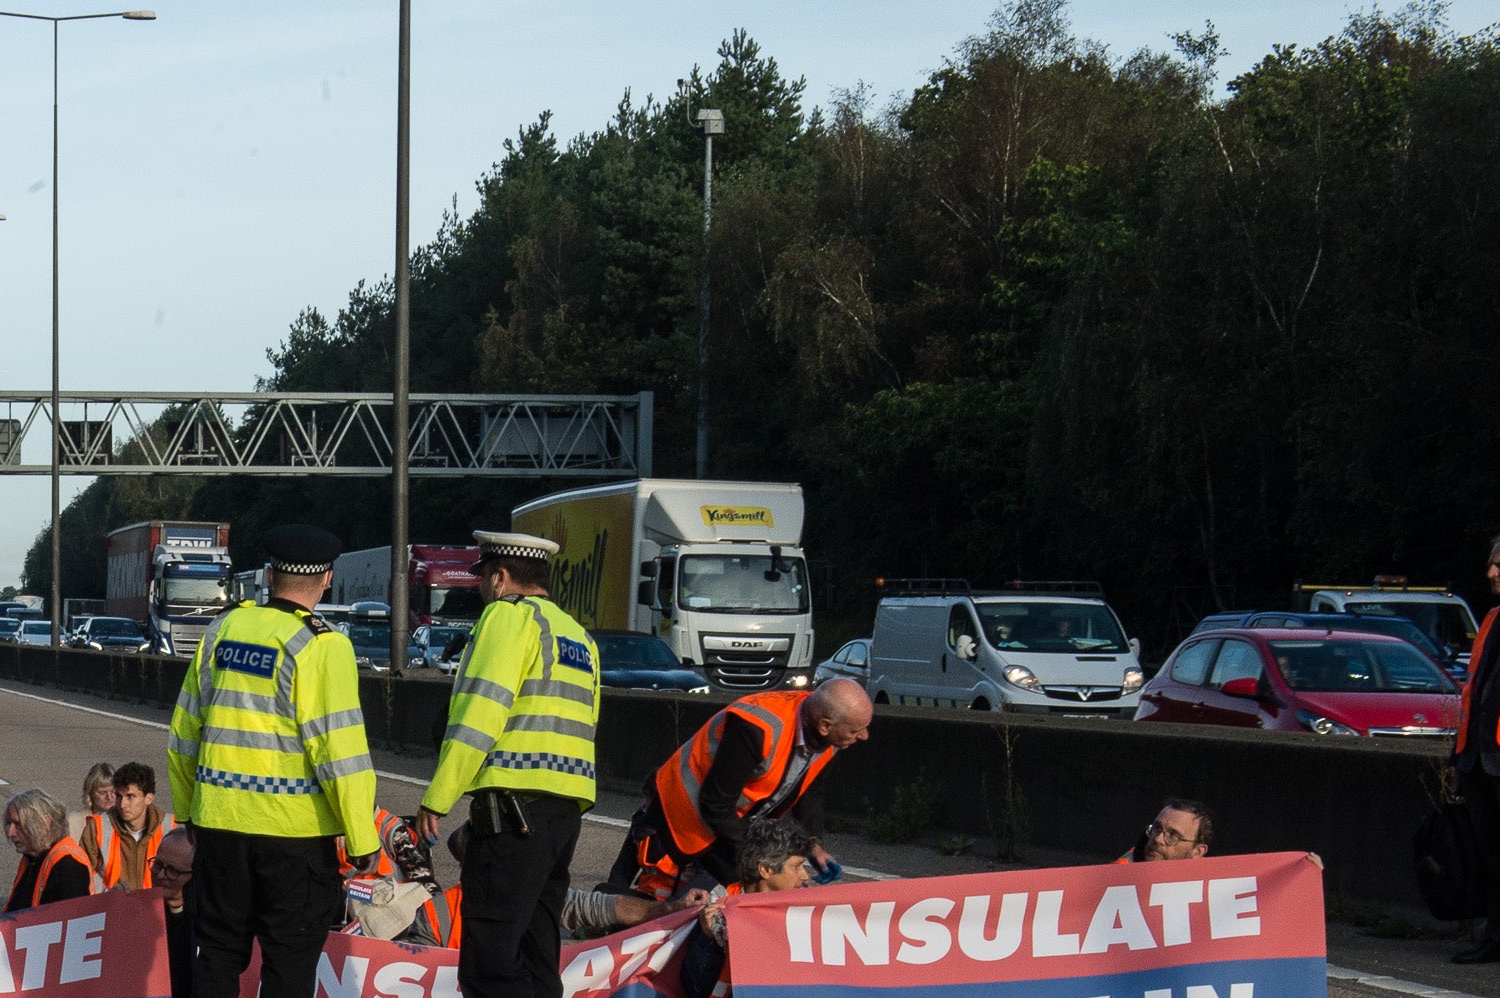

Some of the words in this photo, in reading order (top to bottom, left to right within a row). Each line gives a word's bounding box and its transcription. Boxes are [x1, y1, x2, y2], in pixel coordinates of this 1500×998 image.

[706, 509, 766, 522] Kingsmill
[216, 647, 273, 670] POLICE
[560, 642, 592, 666] POLIC
[786, 876, 1261, 967] INSULATE
